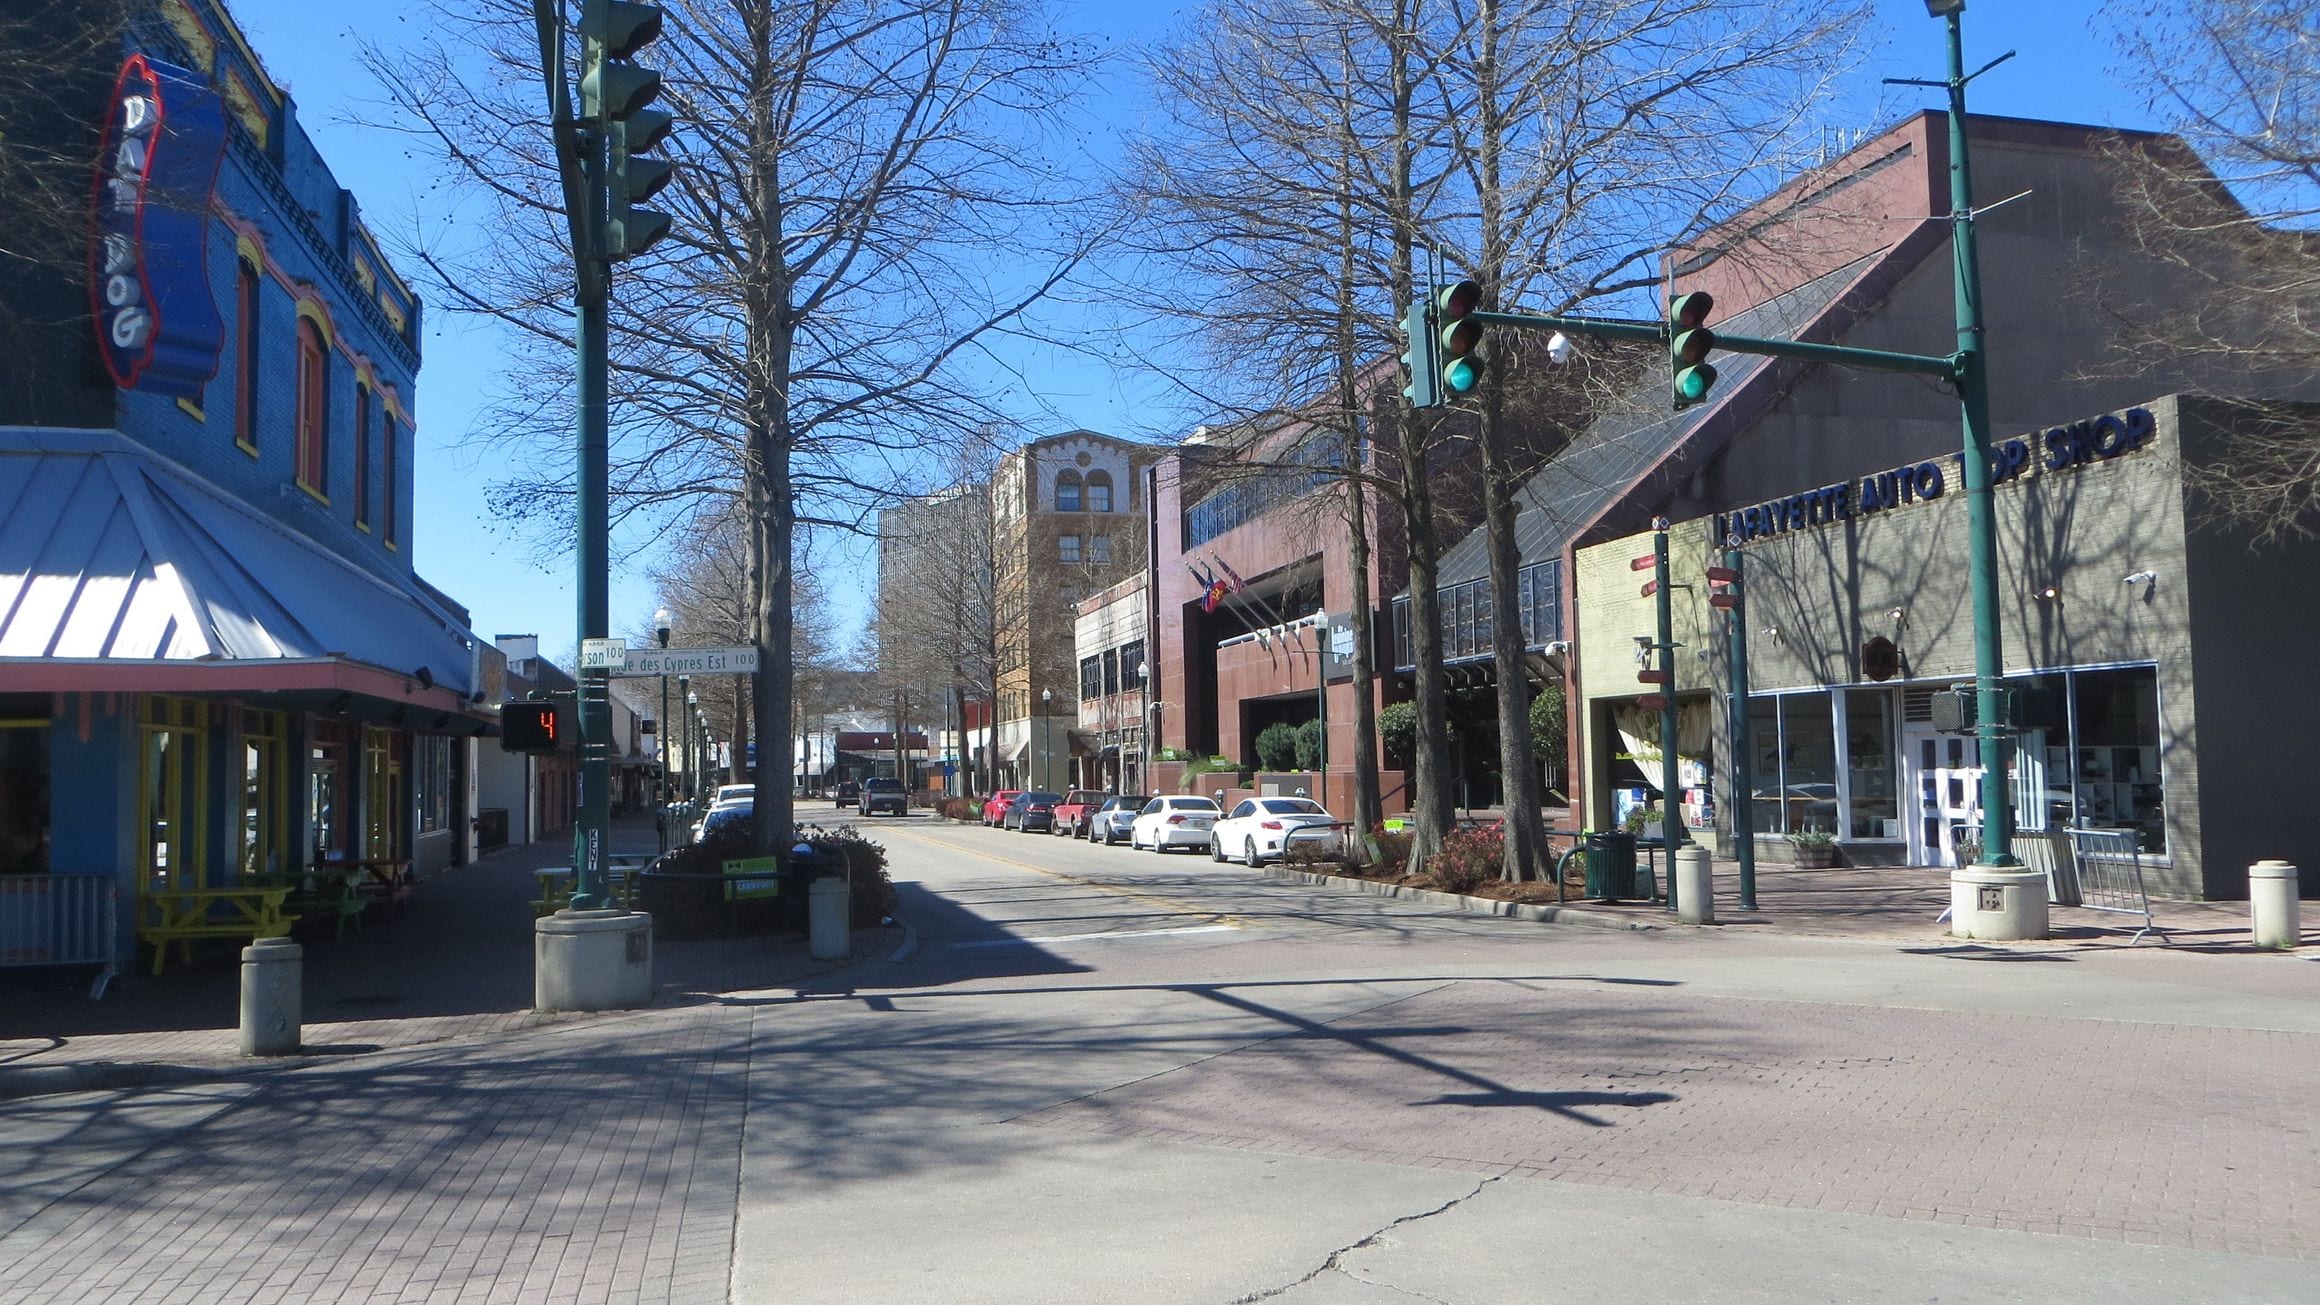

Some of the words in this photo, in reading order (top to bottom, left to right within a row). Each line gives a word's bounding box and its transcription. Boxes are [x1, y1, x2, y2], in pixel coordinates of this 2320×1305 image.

[104, 233, 149, 349] DOG
[1716, 484, 1849, 547] LAFAYETTE
[1861, 462, 1944, 514] AUTO
[2045, 408, 2157, 471] SHOP
[606, 647, 624, 658] 100
[640, 658, 660, 672] des
[664, 656, 703, 672] Cypres
[708, 655, 727, 669] Est
[735, 654, 755, 665] 100
[540, 711, 555, 740] 4
[588, 829, 598, 870] KENT
